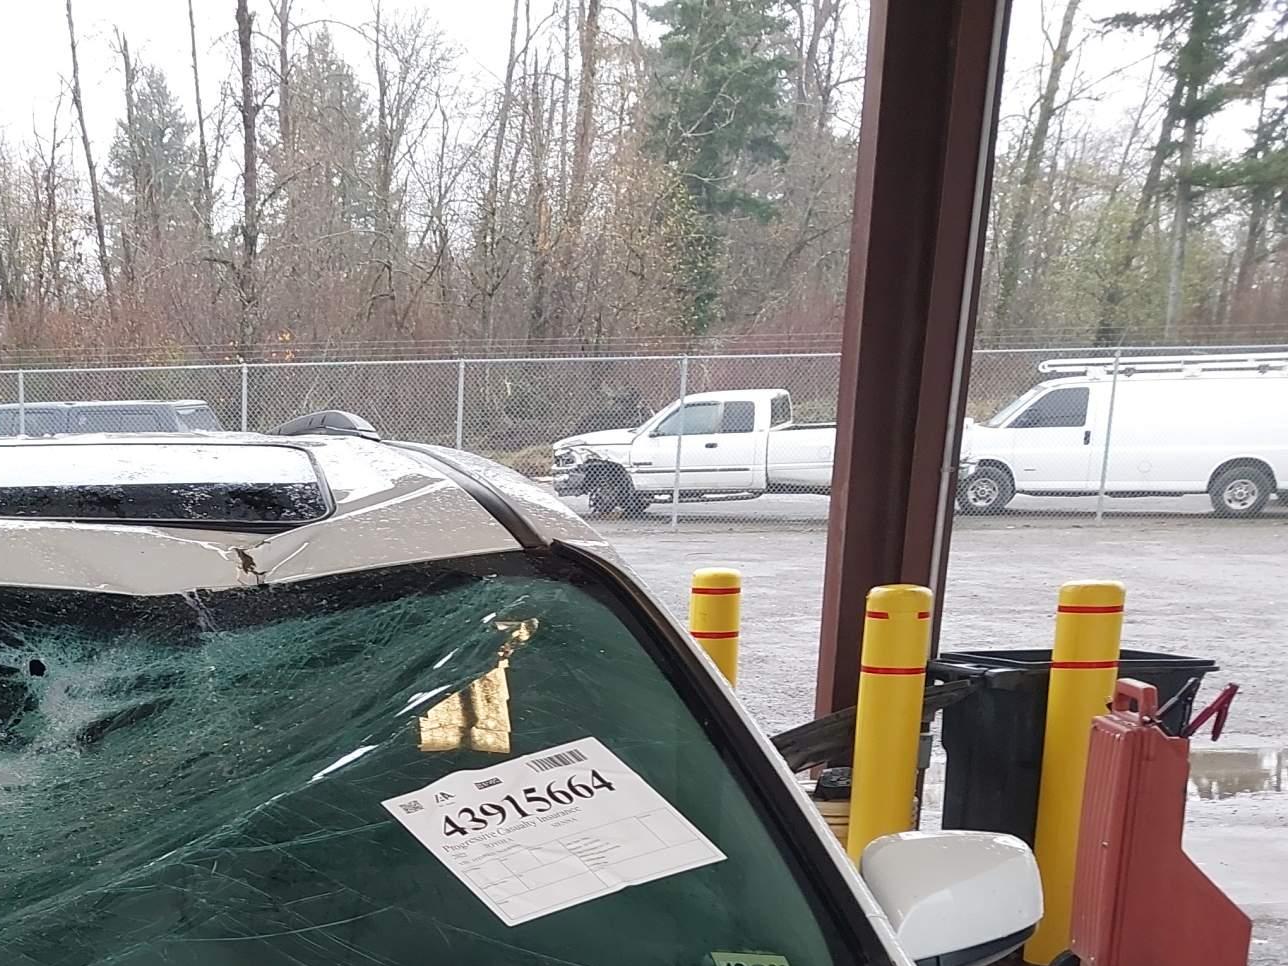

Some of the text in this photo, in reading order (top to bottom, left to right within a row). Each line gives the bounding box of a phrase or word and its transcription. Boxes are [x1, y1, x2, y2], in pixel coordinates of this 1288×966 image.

[442, 806, 582, 853] Progressive Casualty Insurance
[443, 769, 616, 836] 43915664
